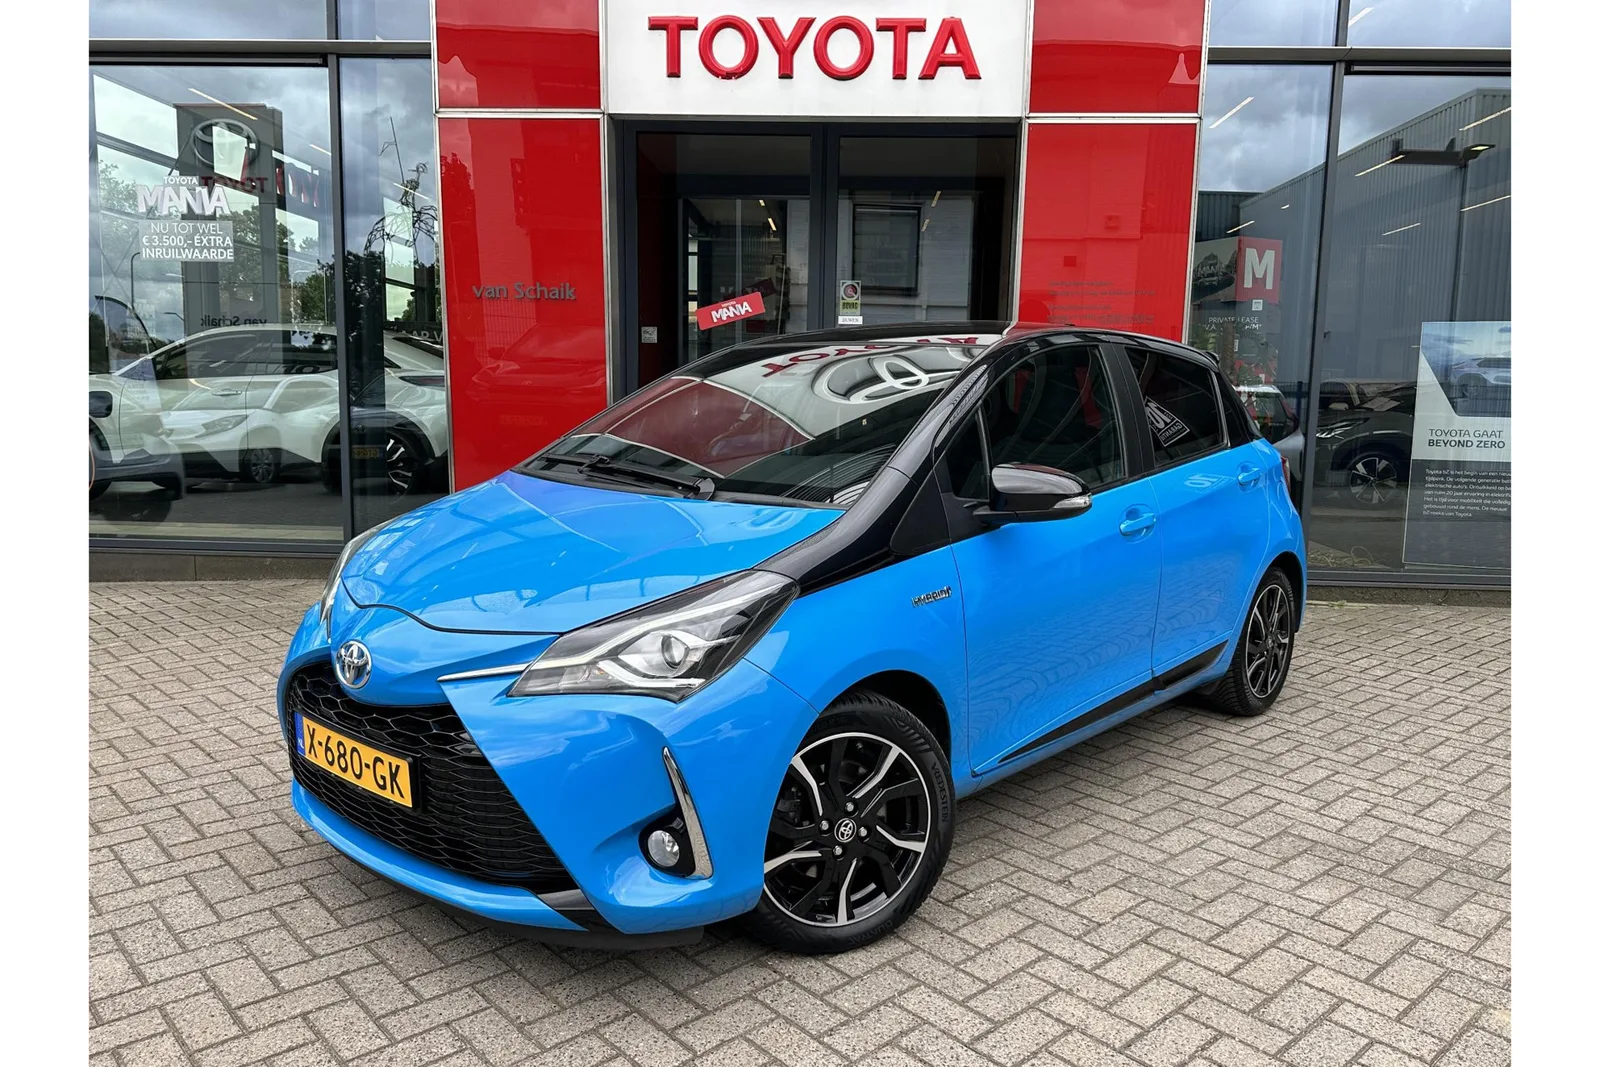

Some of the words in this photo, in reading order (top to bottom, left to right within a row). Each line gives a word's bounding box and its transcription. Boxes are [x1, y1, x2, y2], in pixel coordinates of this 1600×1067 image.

[647, 14, 982, 81] TOYOTA
[163, 176, 198, 185] TOYOTA
[136, 184, 232, 218] MANIA
[151, 223, 168, 234] NU
[174, 223, 194, 234] TOT
[196, 223, 223, 234] WEL
[142, 248, 234, 260] INRUILWAARDE
[1244, 248, 1276, 290] M
[472, 284, 508, 298] van
[514, 281, 576, 300] Schaik
[710, 301, 752, 322] MANIA
[1429, 428, 1470, 438] TOYOTA
[1473, 430, 1504, 438] GAAT
[1428, 439, 1474, 448] BEYOND
[1476, 440, 1506, 449] ZERO
[911, 585, 952, 608] HYBRID
[306, 724, 405, 800] X-680-GK
[931, 762, 949, 822] VREDESTEIN
